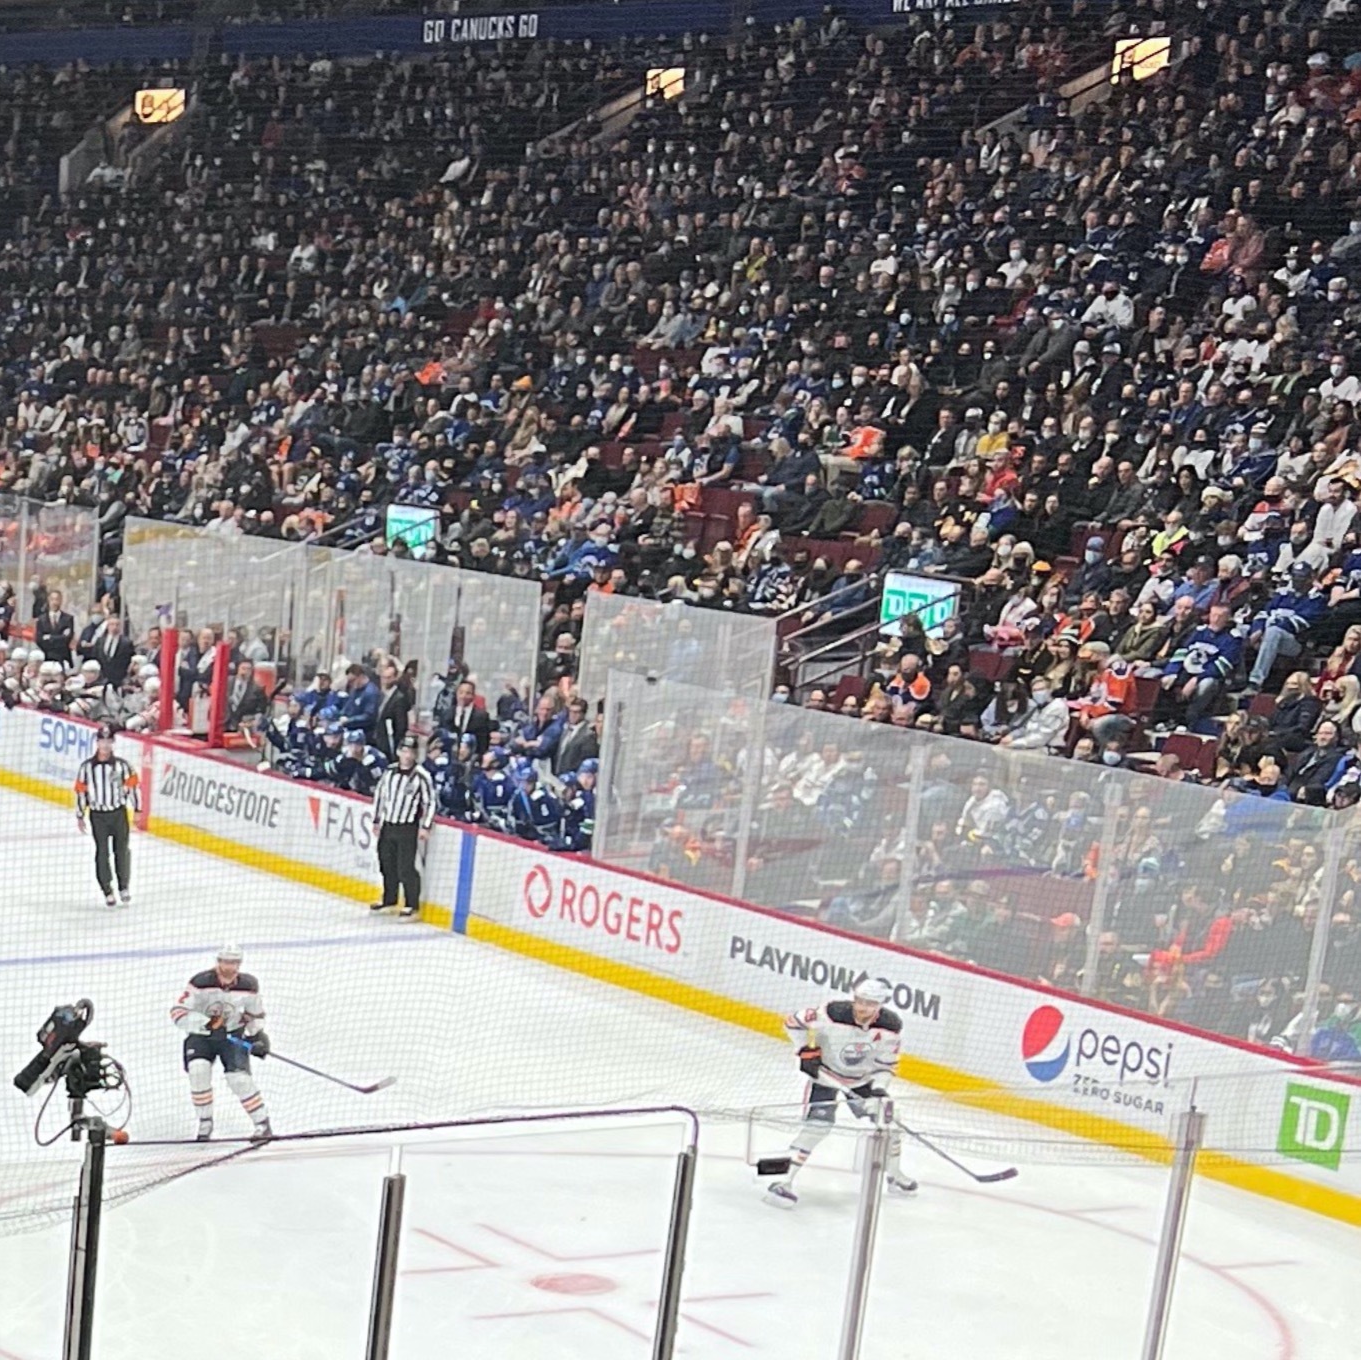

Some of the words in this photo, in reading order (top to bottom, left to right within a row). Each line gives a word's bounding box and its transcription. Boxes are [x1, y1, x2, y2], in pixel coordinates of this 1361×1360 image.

[423, 20, 445, 43] GO
[451, 16, 515, 41] CANUCKS
[518, 14, 538, 38] GO
[160, 764, 280, 829] BRIDGESTONE
[560, 878, 683, 954] ROGERS
[1076, 1028, 1174, 1086] pepsi
[1113, 1089, 1165, 1115] SUGAR
[1289, 1096, 1340, 1151] TD
